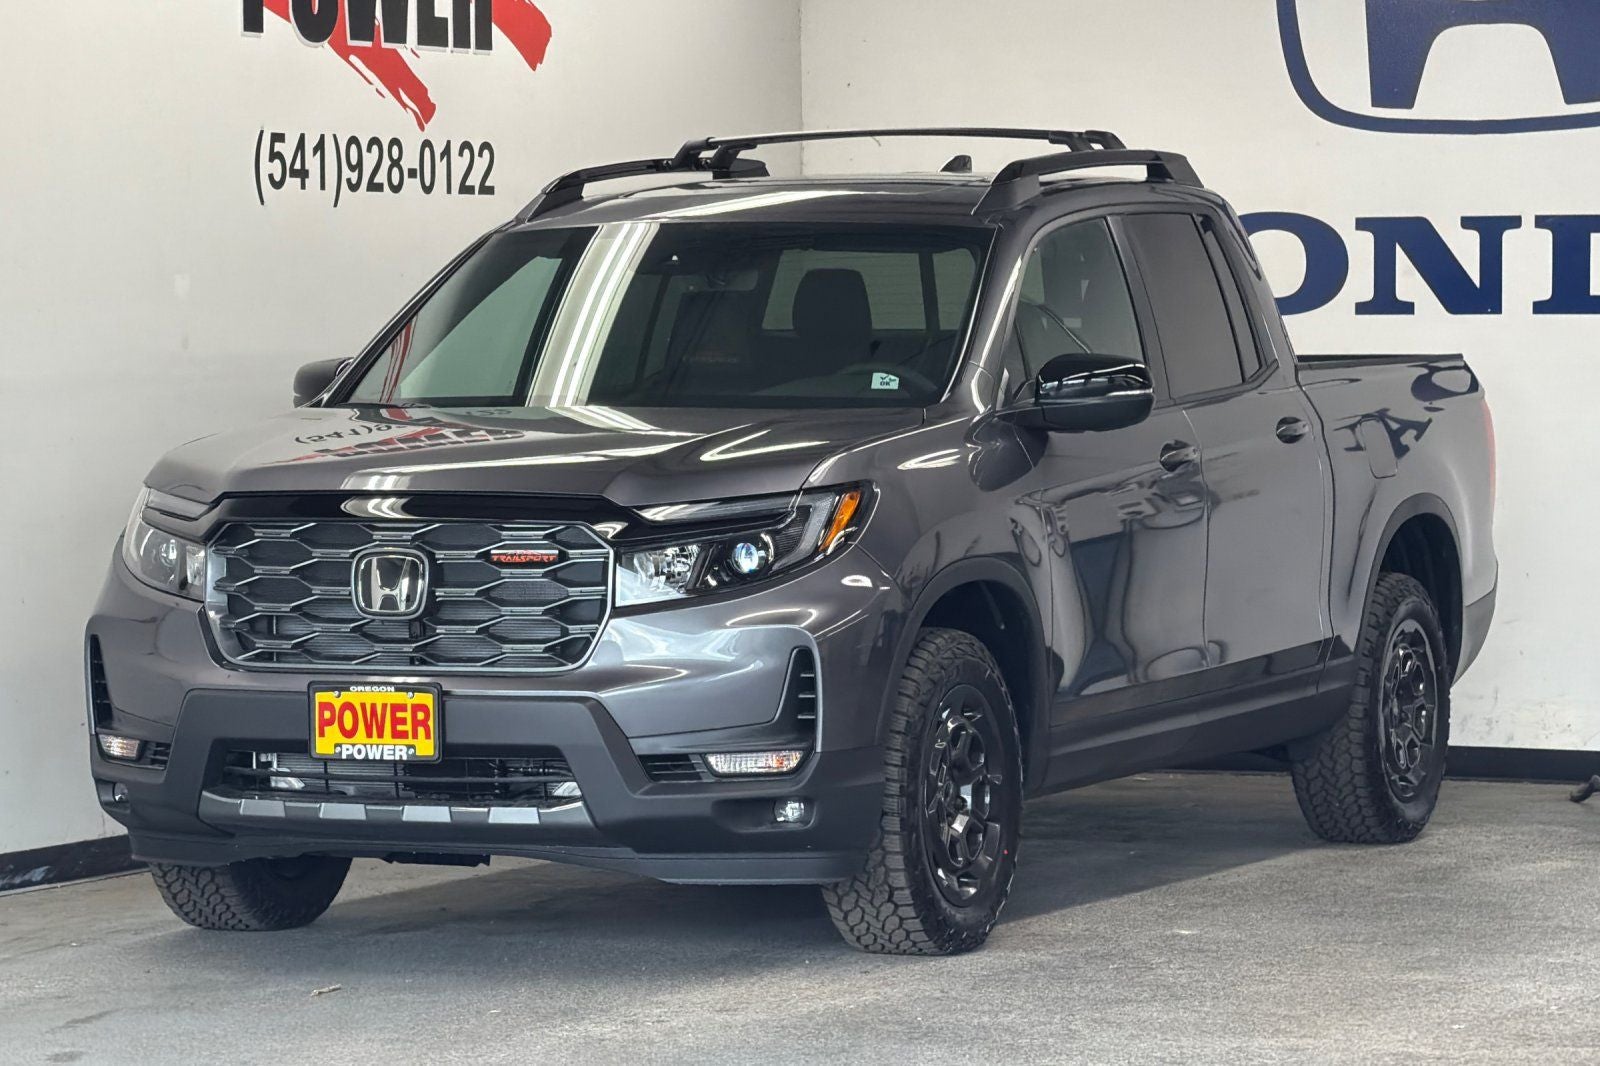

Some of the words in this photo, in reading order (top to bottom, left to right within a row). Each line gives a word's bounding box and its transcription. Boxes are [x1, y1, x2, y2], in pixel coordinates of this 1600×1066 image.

[255, 129, 495, 207] (541)928-0122
[318, 701, 431, 740] POWER
[341, 744, 408, 760] POWER
